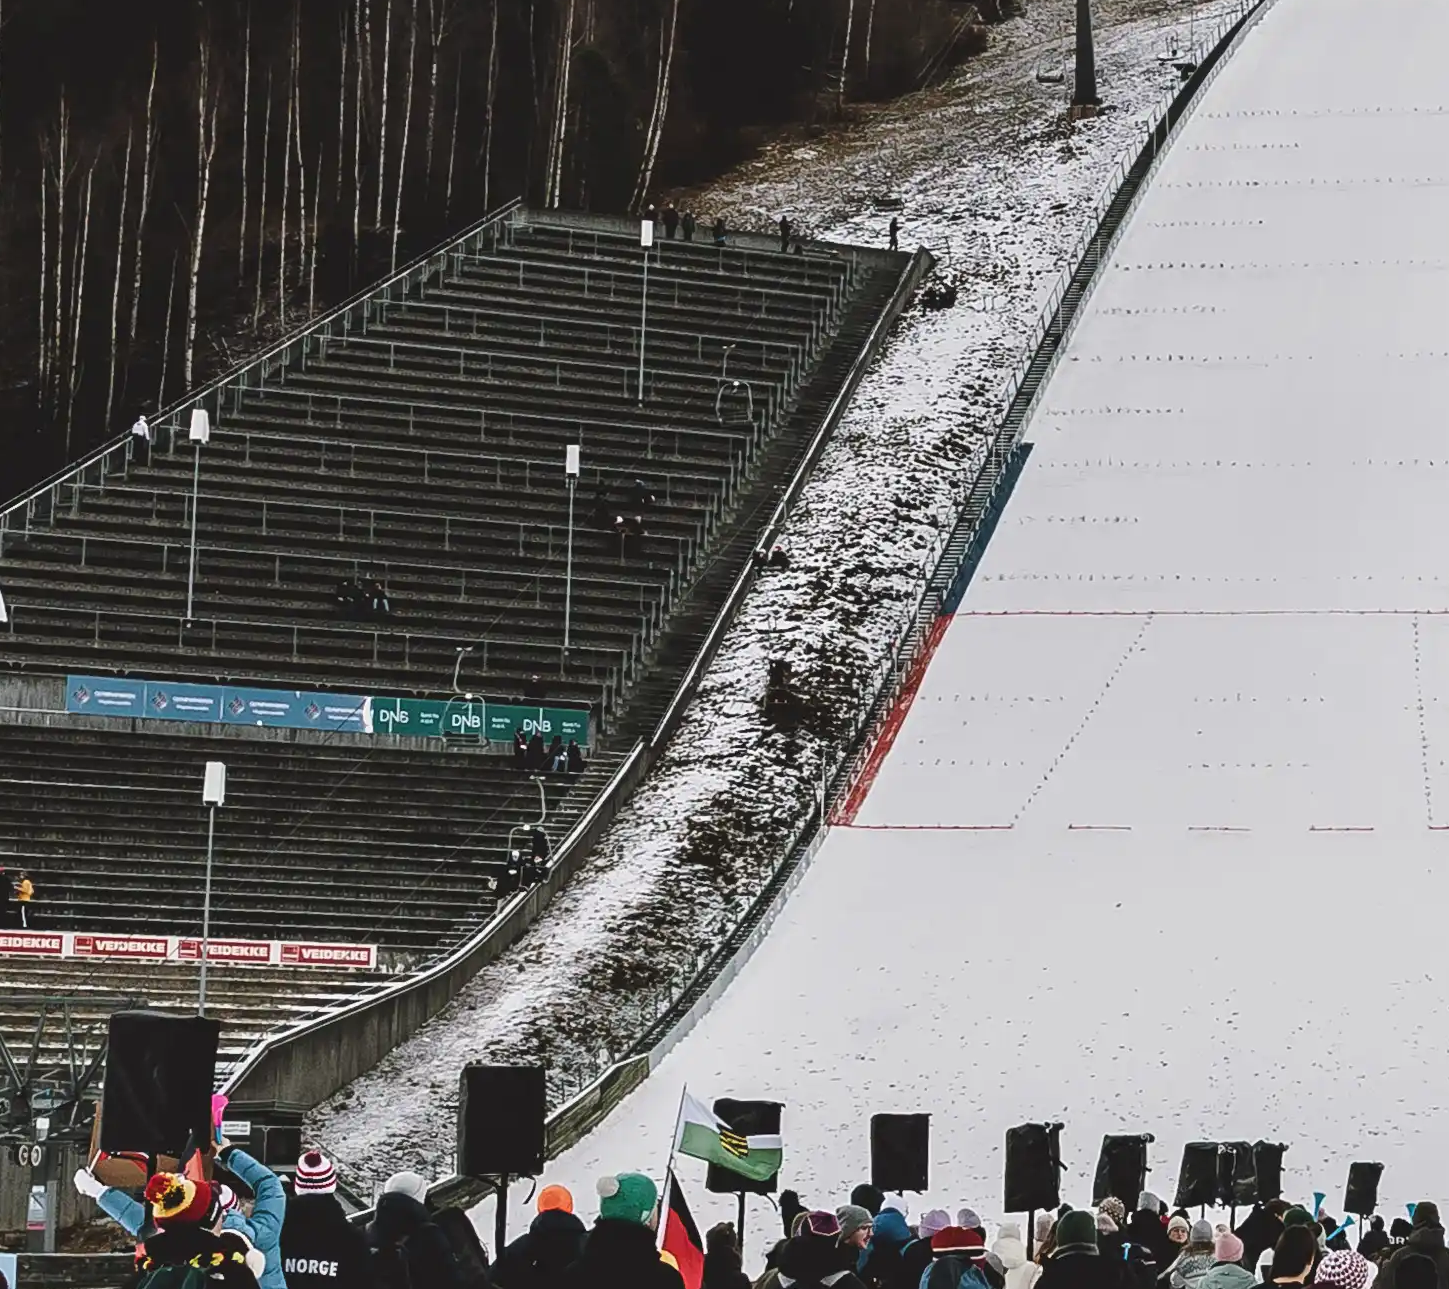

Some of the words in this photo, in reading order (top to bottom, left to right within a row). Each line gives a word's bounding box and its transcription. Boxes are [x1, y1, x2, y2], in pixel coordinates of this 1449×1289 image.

[95, 940, 166, 953] VEIDEKKE
[301, 948, 368, 962] VEIDEKKE
[285, 1258, 338, 1277] NORGE
